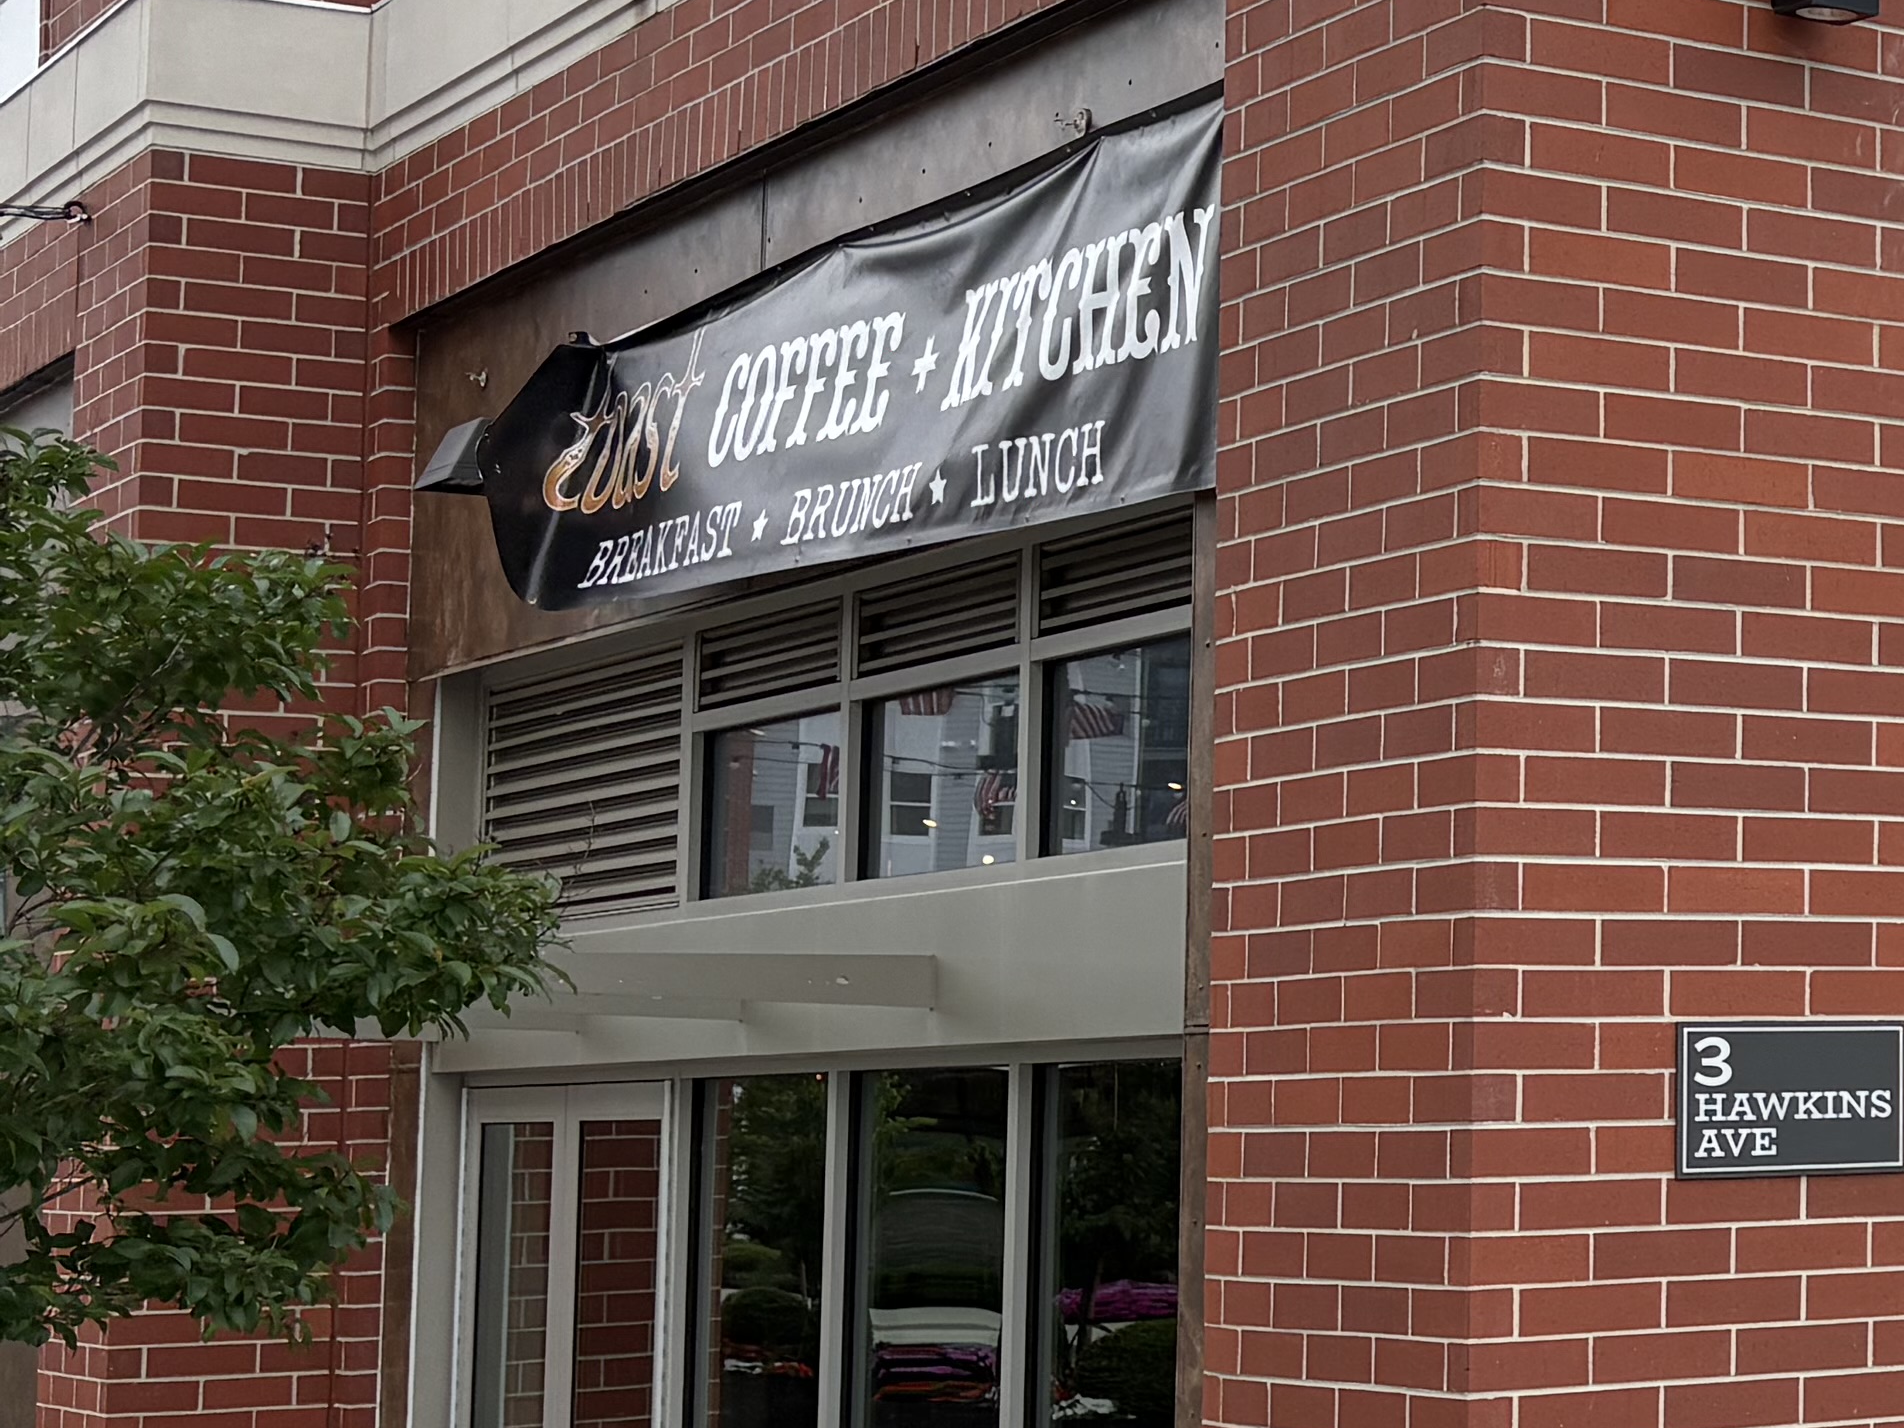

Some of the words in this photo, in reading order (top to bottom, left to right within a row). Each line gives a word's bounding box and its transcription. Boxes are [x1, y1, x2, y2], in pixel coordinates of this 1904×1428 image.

[543, 324, 706, 514] toast
[708, 311, 906, 468] COFFEE
[940, 203, 1216, 409] KITCHEN
[577, 501, 743, 589] BREAKFAST
[780, 461, 921, 546] BRUNCH
[969, 420, 1106, 509] LUNCH
[1693, 1036, 1733, 1087] 3
[1694, 1090, 1892, 1122] HAWKINS
[1694, 1127, 1777, 1158] AVE
